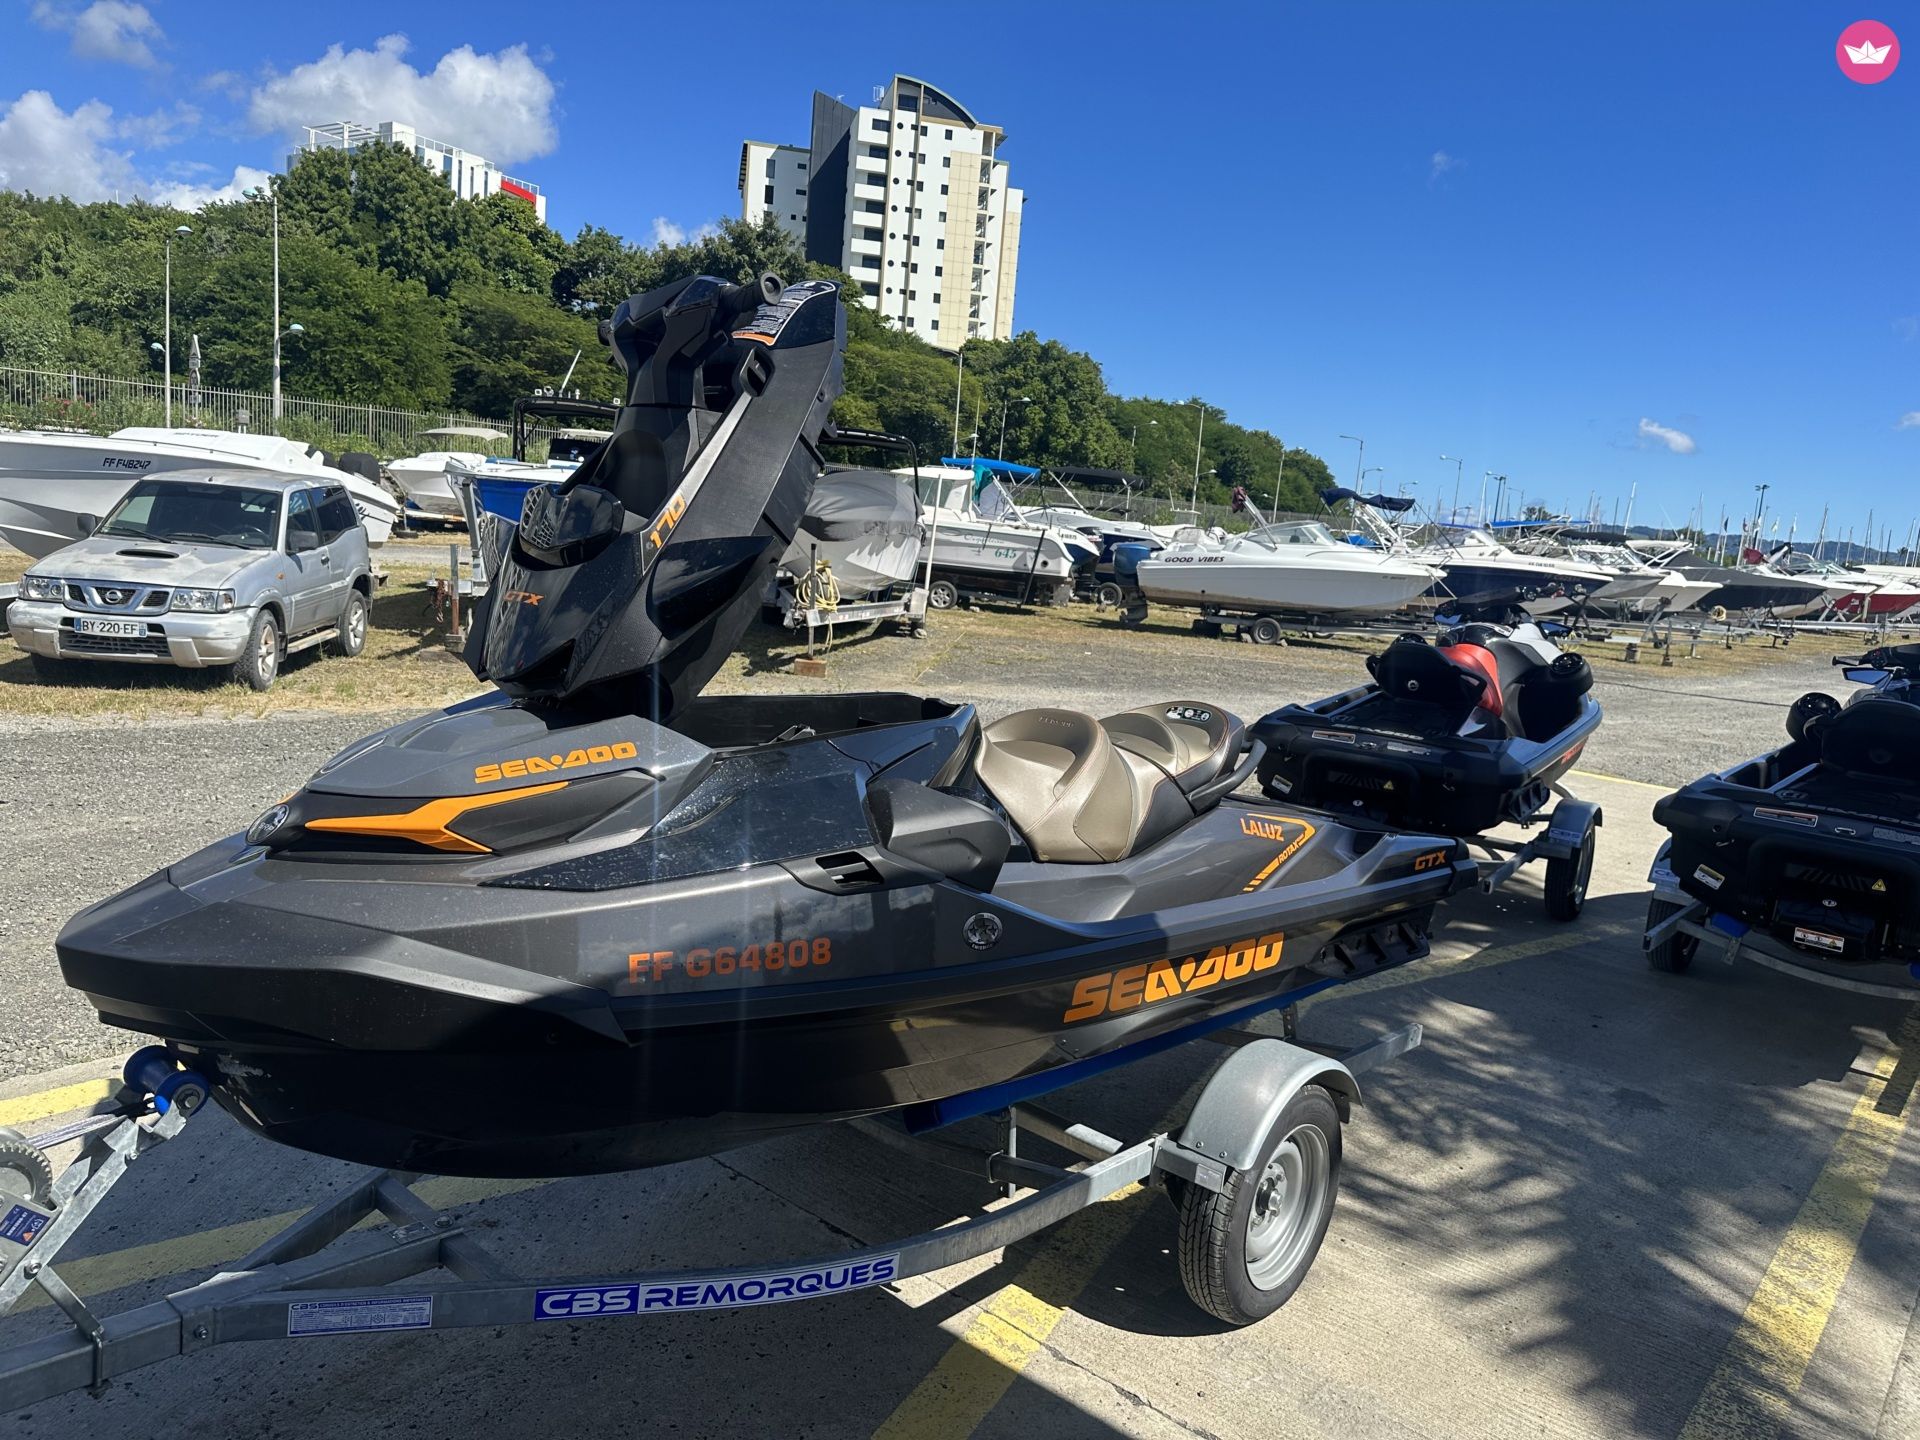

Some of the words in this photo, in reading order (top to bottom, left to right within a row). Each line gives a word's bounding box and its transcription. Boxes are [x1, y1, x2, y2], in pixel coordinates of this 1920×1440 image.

[102, 457, 116, 467] FF
[650, 494, 687, 549] 170
[995, 548, 1017, 559] 645
[503, 590, 545, 606] GTX
[1240, 817, 1285, 842] LALUZ
[1278, 840, 1301, 864] ROTAX
[1414, 850, 1447, 871] GTX
[628, 951, 674, 984] FF
[686, 937, 832, 977] G64808
[542, 1291, 632, 1315] CBS
[644, 1258, 895, 1308] REMORQUES
